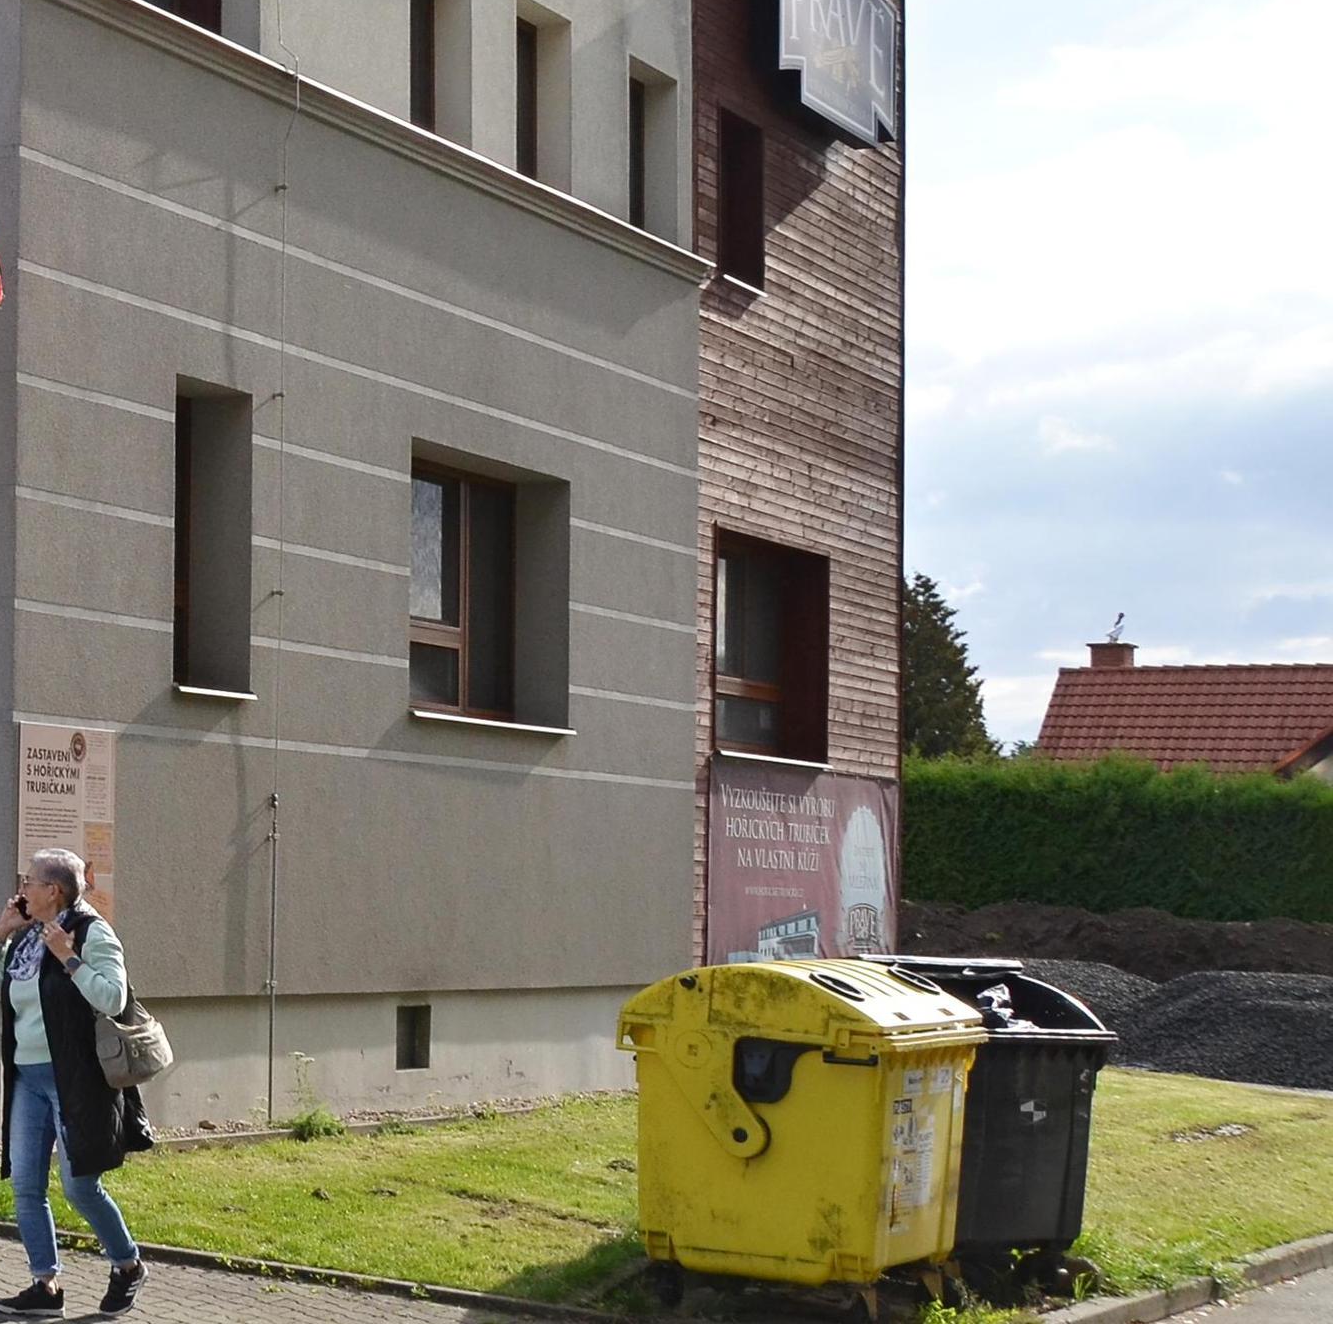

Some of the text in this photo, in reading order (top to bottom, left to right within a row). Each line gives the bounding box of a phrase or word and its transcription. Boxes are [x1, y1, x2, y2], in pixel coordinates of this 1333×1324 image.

[27, 764, 32, 776] S
[26, 779, 76, 795] TRUBIČKAMI
[721, 783, 786, 814] VYZKOUŠEJTE
[726, 814, 785, 842] HOŘICKÝCH
[737, 847, 753, 868] NA
